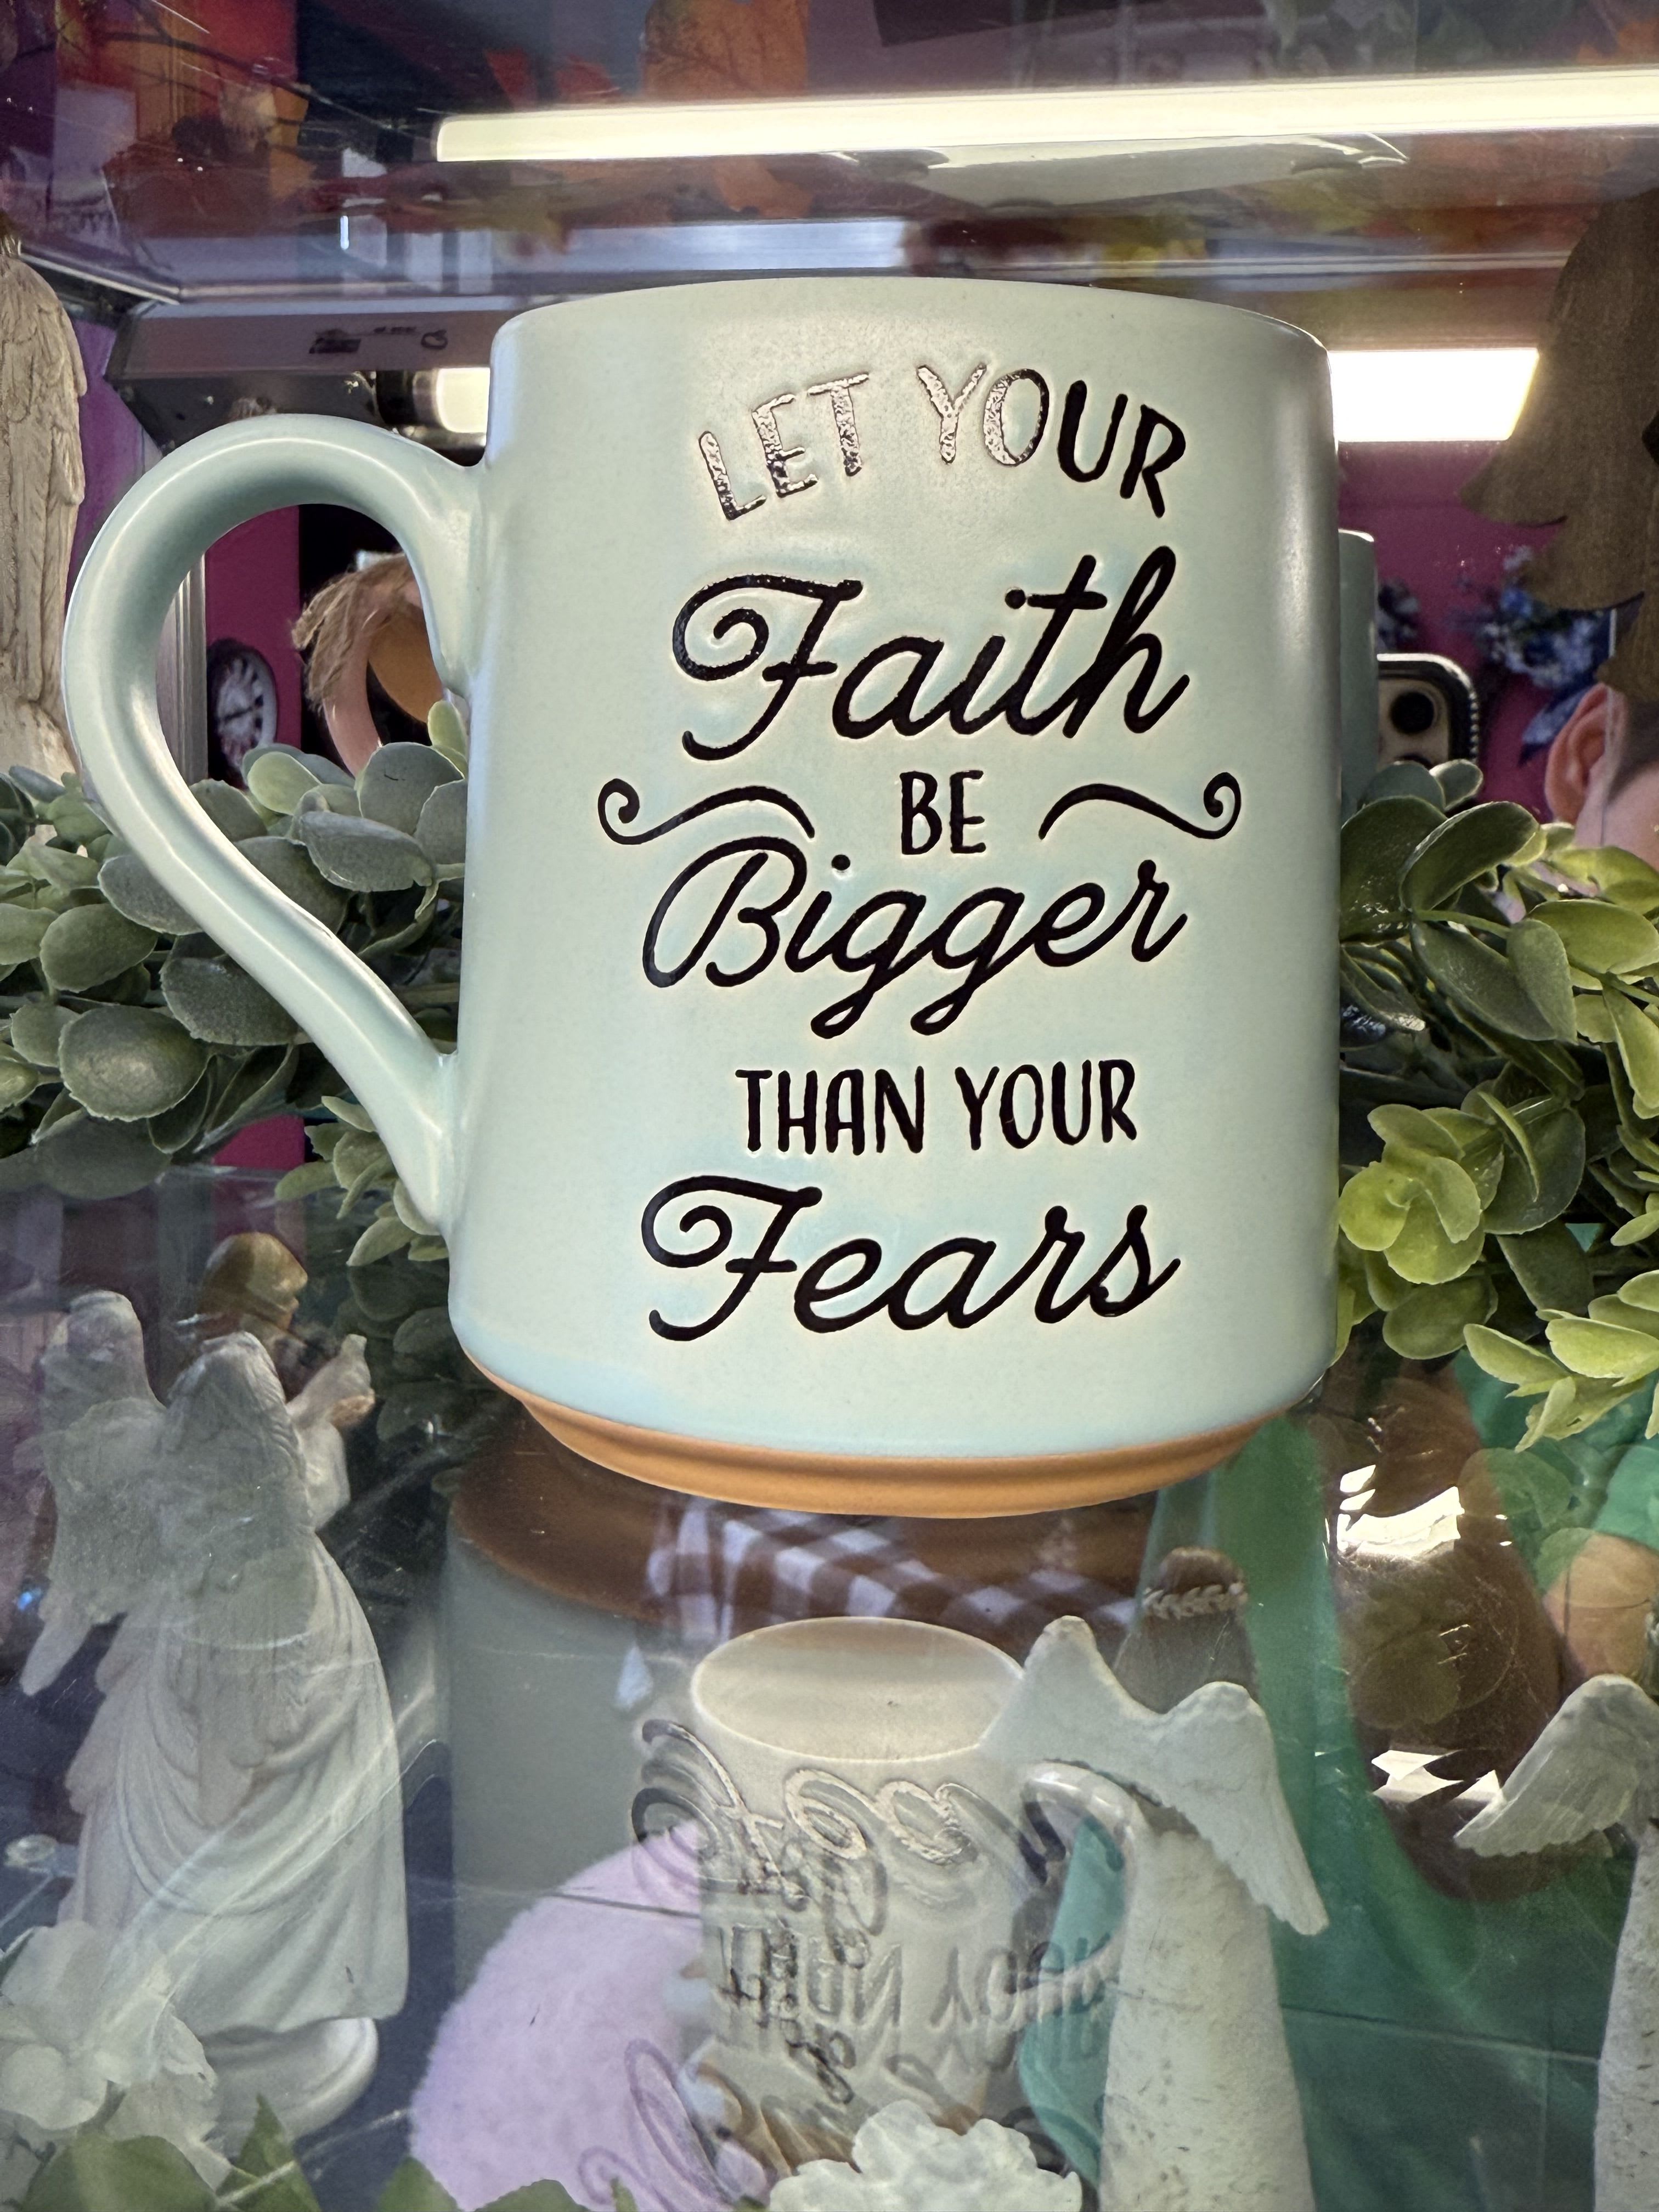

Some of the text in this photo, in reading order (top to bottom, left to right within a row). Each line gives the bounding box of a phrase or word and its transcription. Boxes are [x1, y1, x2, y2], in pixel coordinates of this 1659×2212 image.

[699, 363, 1186, 520] LET YOUR
[672, 545, 1190, 761] Faith
[899, 770, 986, 855] BE
[642, 836, 1188, 1039] Bigger
[735, 1059, 1137, 1156] THAN YOUR
[641, 1175, 1181, 1341] Fears
